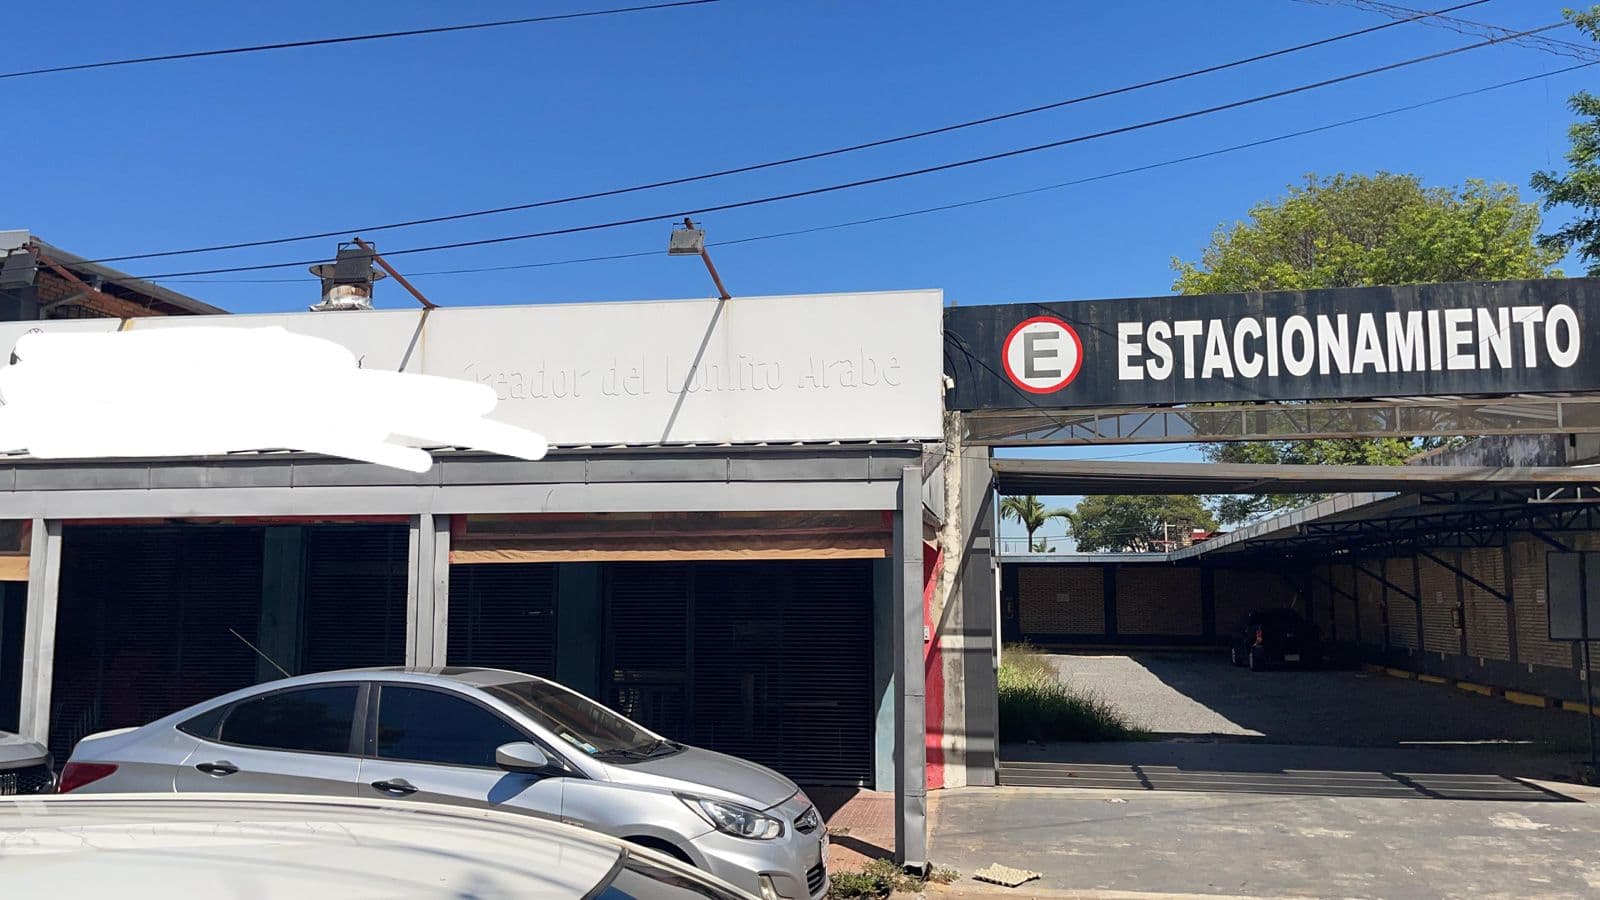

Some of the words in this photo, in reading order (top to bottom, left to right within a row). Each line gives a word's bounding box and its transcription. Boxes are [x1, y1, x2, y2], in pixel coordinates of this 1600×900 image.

[1023, 331, 1062, 379] E
[1117, 303, 1580, 381] ESTACIONAMIENTO
[600, 353, 650, 398] del
[798, 345, 902, 388] Arabe
